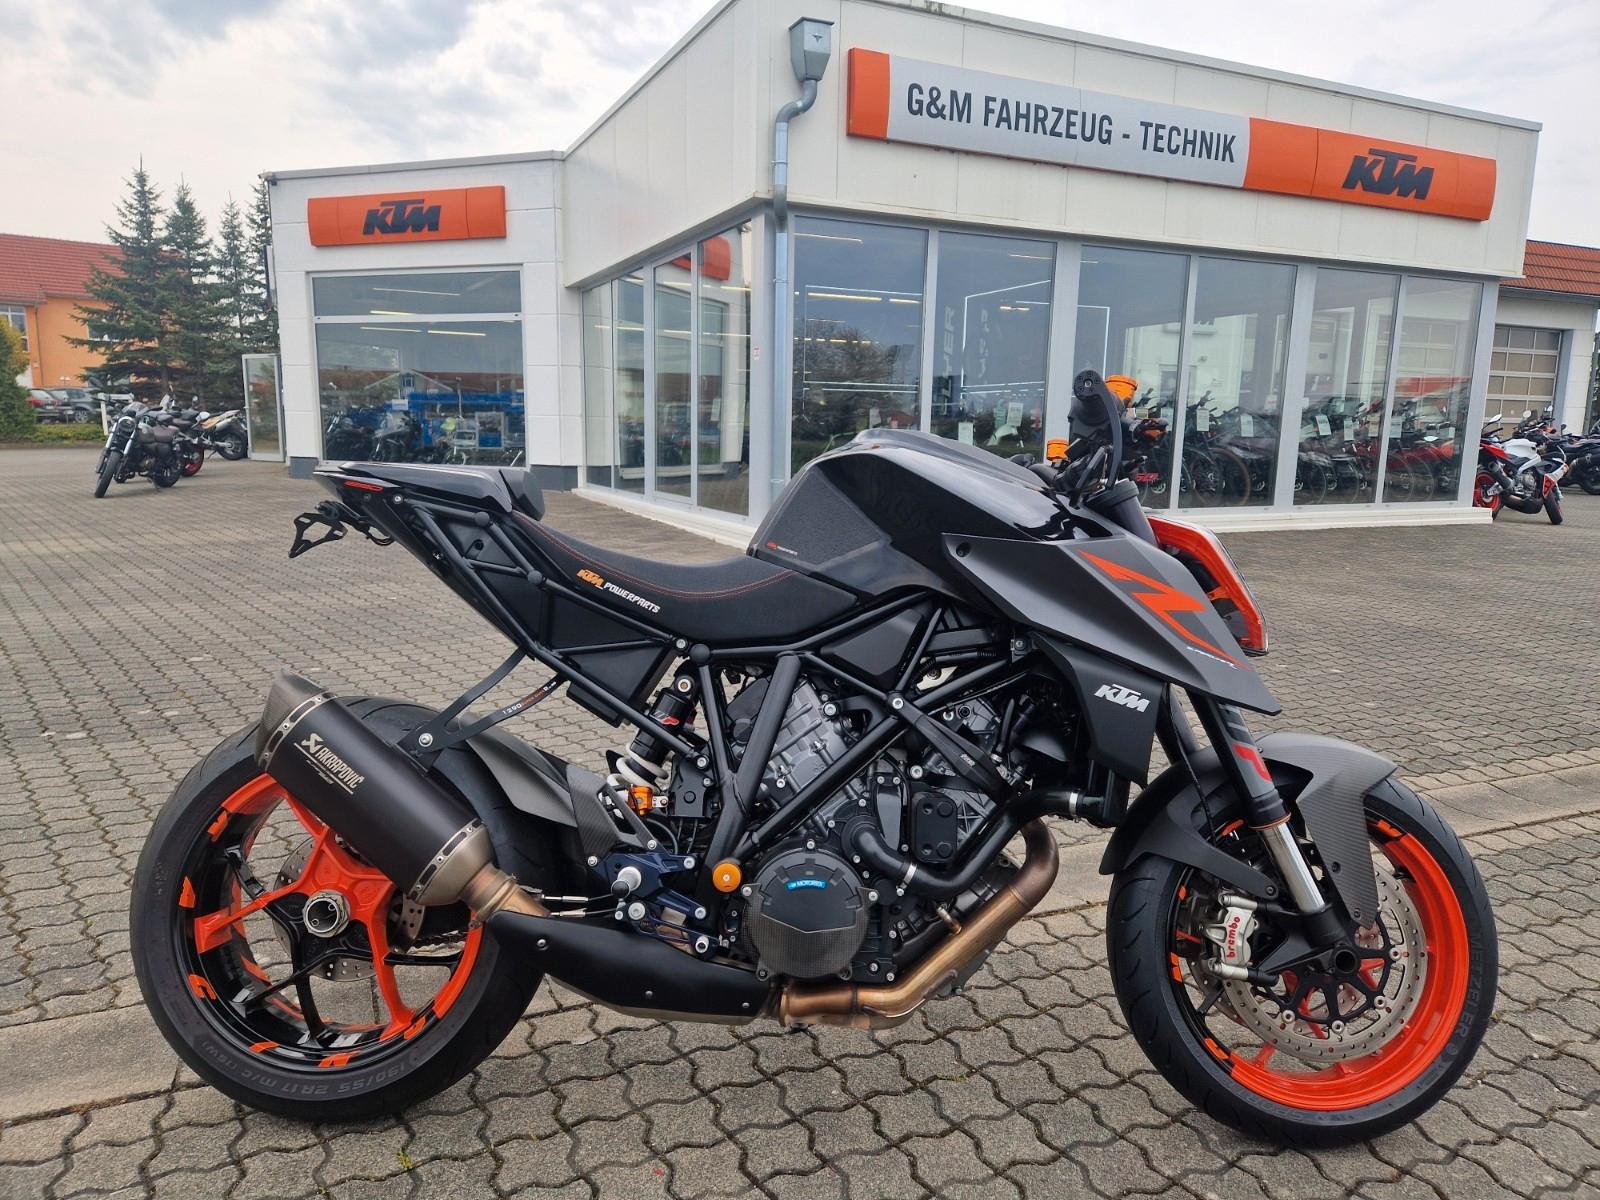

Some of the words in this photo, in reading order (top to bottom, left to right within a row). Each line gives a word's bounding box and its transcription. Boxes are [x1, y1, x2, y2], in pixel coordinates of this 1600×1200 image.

[907, 82, 972, 124] G&M
[983, 95, 1113, 145] FAHRZEUG
[1139, 121, 1237, 163] TECHNIK
[1342, 148, 1435, 200] KTM
[362, 199, 442, 235] KTM
[603, 581, 661, 613] POWERPARTS
[1093, 683, 1151, 713] KTM
[1226, 916, 1240, 959] brembo
[1456, 934, 1484, 1037] METZELER
